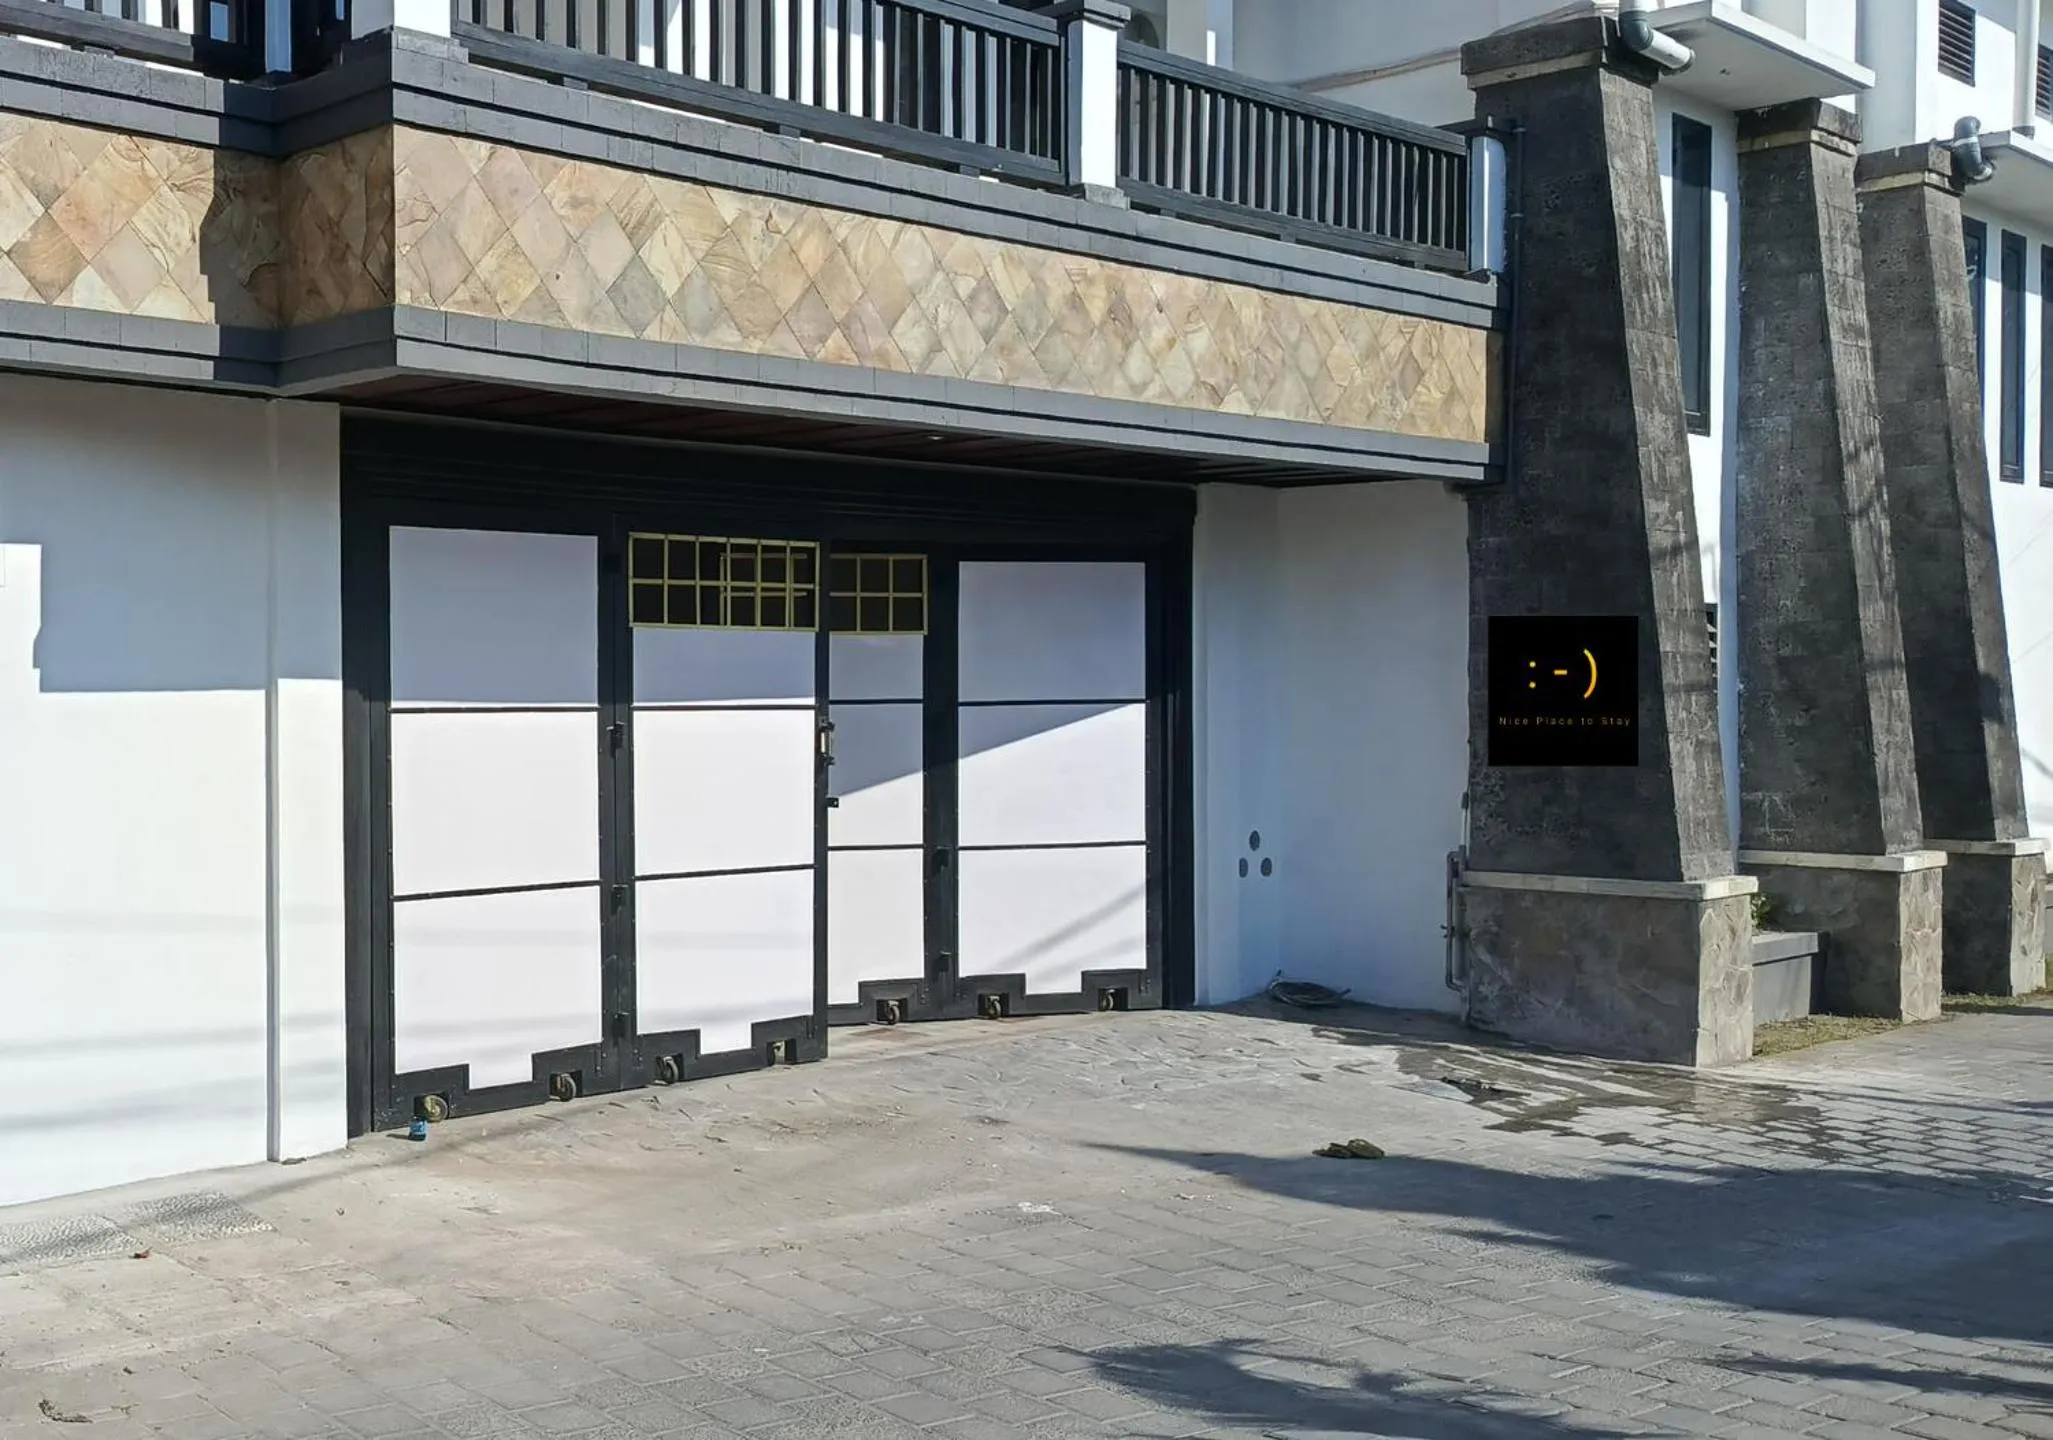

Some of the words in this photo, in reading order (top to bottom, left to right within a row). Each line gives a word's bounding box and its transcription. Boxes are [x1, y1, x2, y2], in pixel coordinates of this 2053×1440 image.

[1499, 716, 1529, 726] Nice
[1536, 716, 1574, 726] Place
[1581, 716, 1594, 726] to
[1601, 716, 1631, 727] Stay
